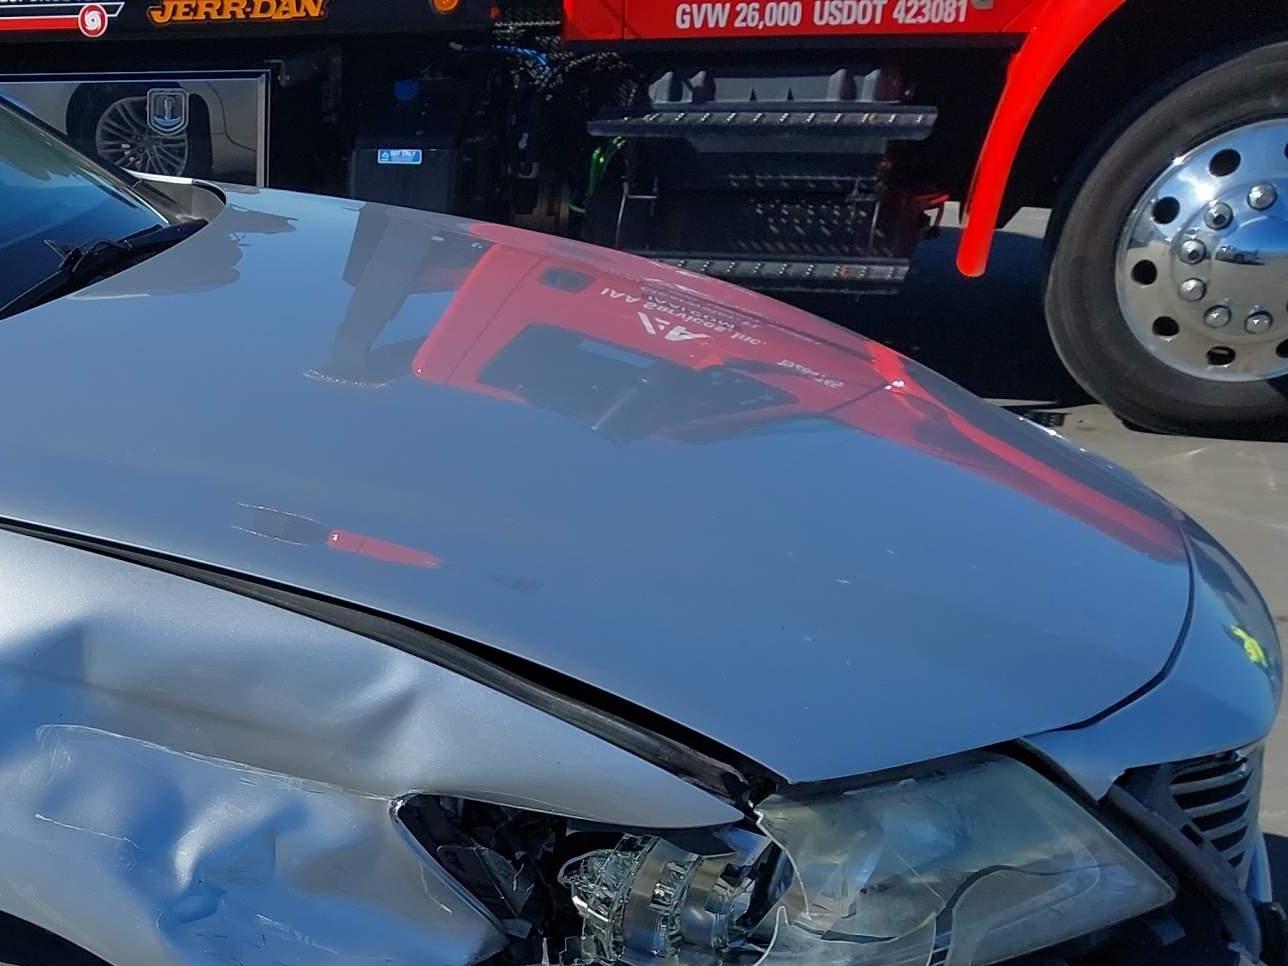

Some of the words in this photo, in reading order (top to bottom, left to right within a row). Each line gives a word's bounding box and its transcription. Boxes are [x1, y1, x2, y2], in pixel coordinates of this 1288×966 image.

[676, 3, 730, 29] GVW
[734, 2, 802, 30] 26,000
[813, 0, 886, 26] USDOT
[892, 0, 968, 24] 423081
